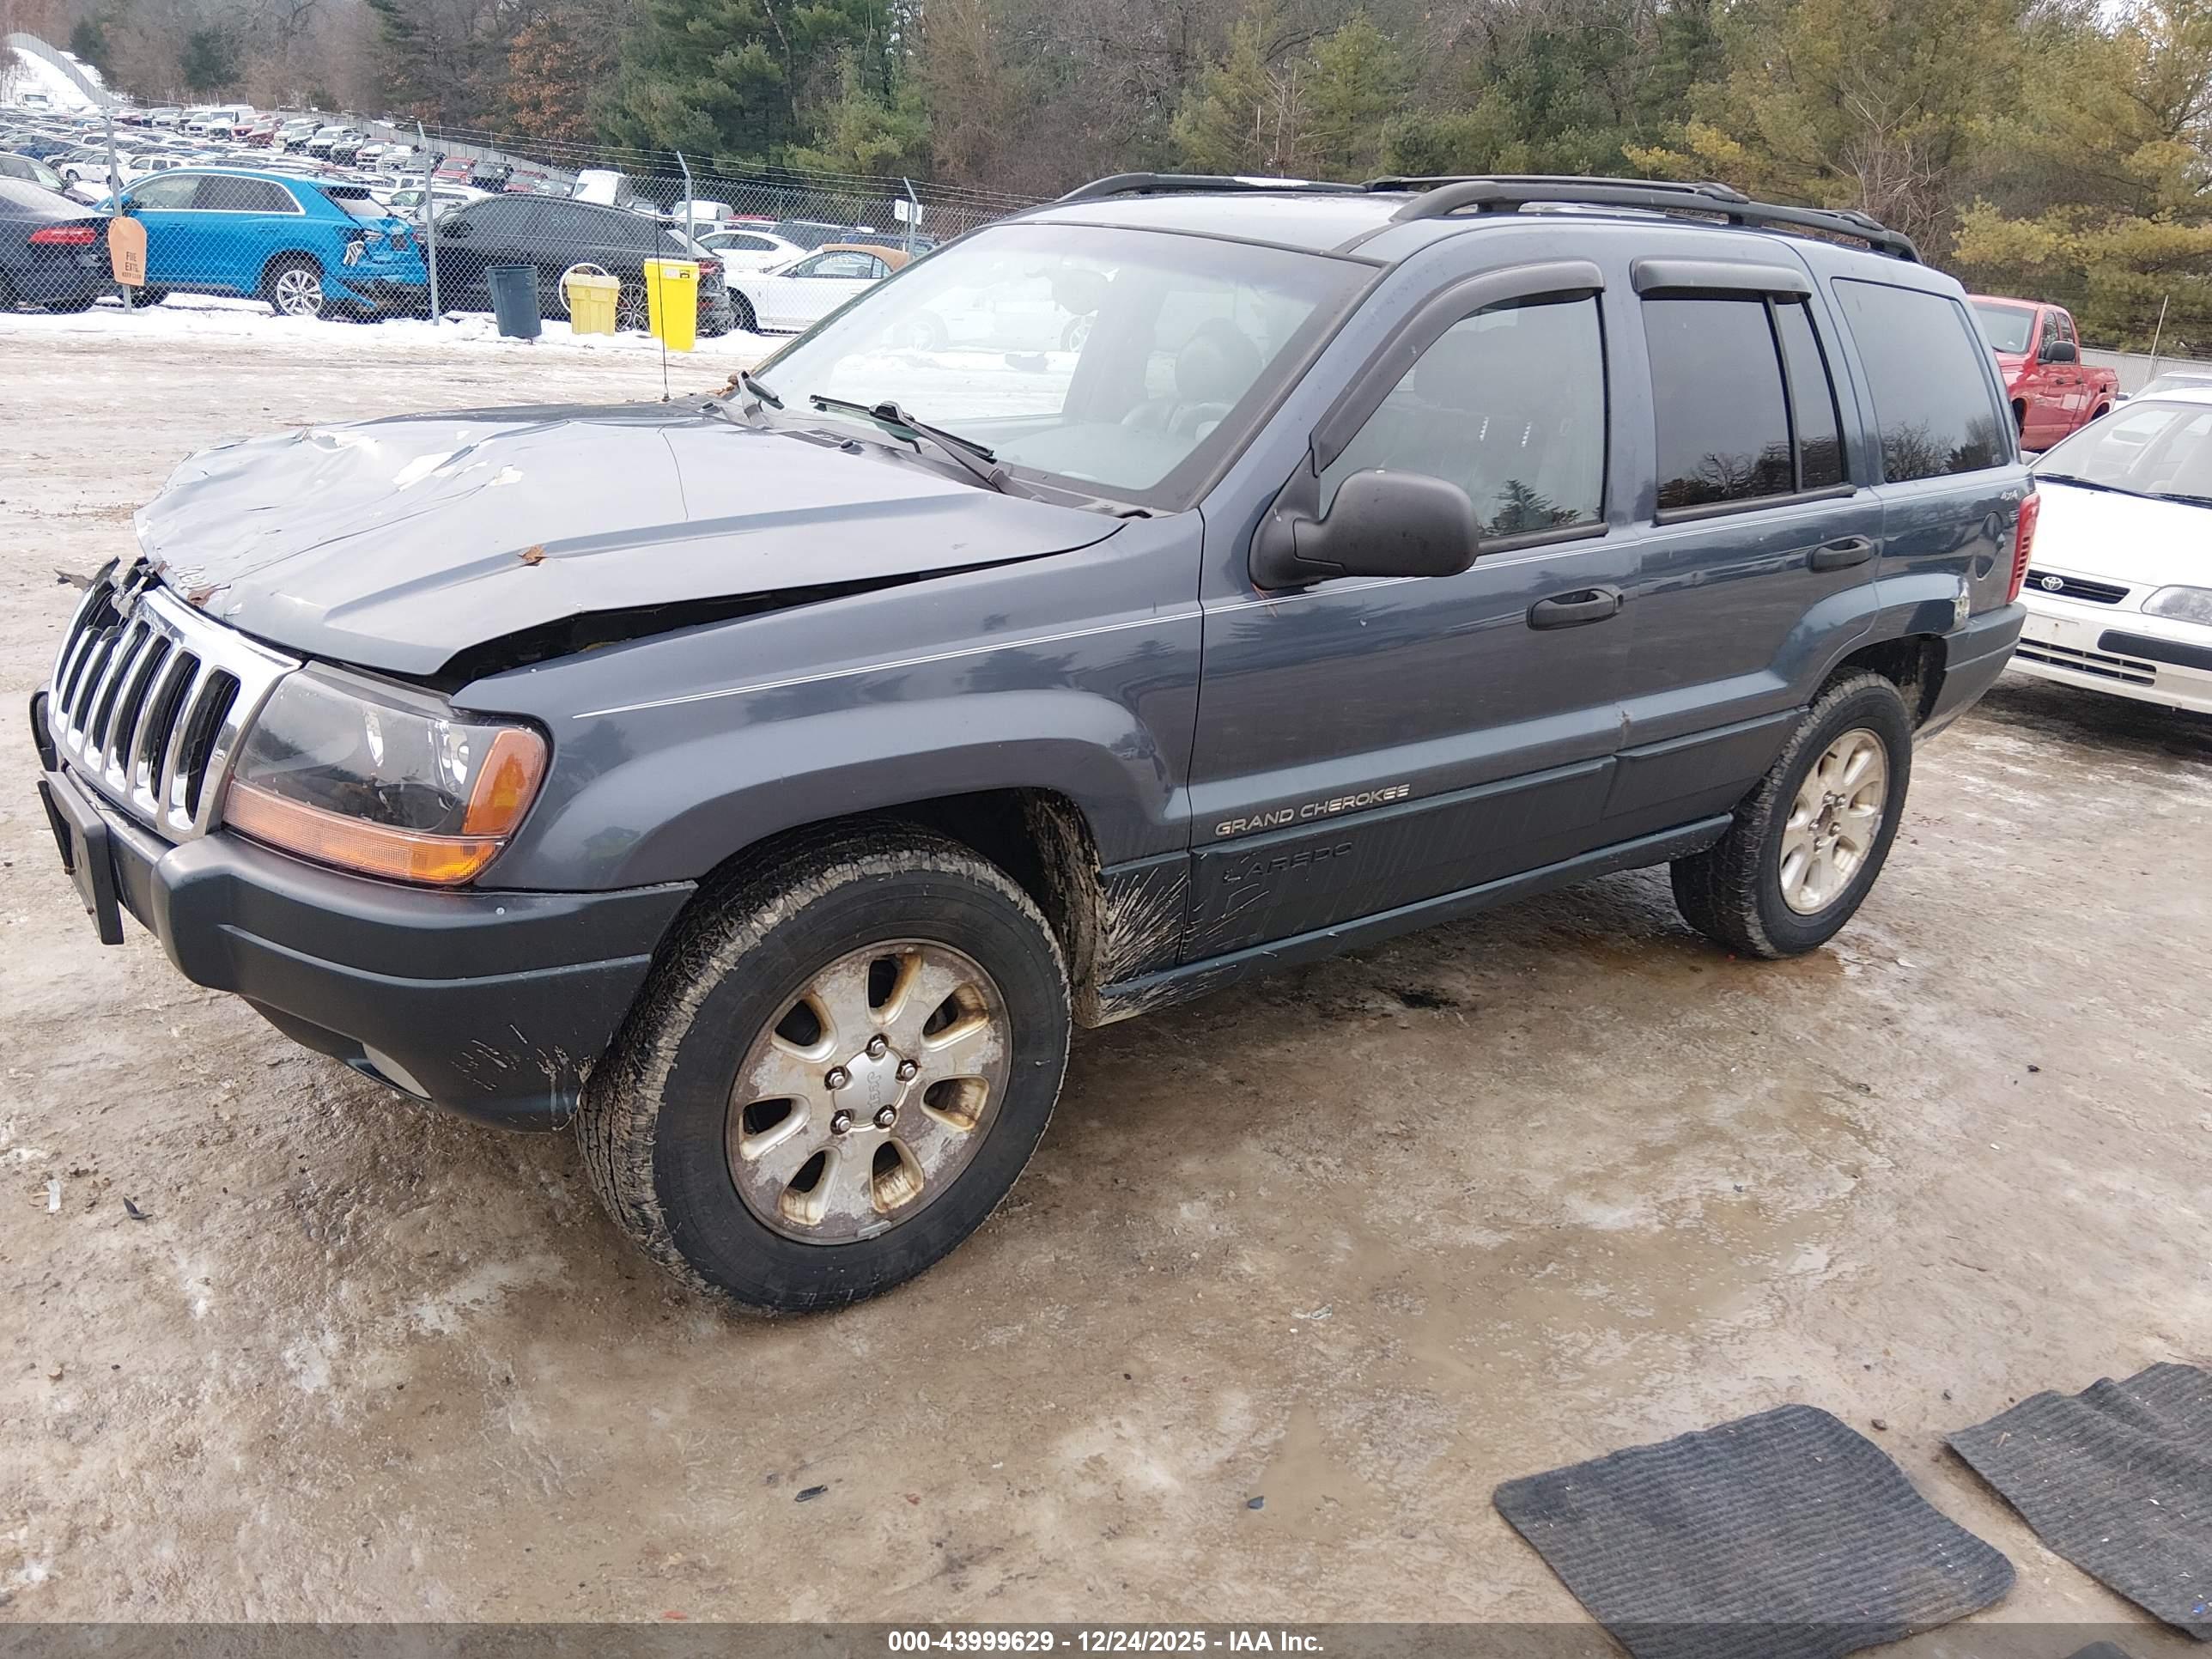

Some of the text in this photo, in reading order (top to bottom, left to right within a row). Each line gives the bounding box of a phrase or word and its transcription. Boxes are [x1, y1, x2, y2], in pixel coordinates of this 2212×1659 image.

[1215, 784, 1410, 836] GRAND CHEROKEE
[1223, 842, 1352, 883] LAREDO
